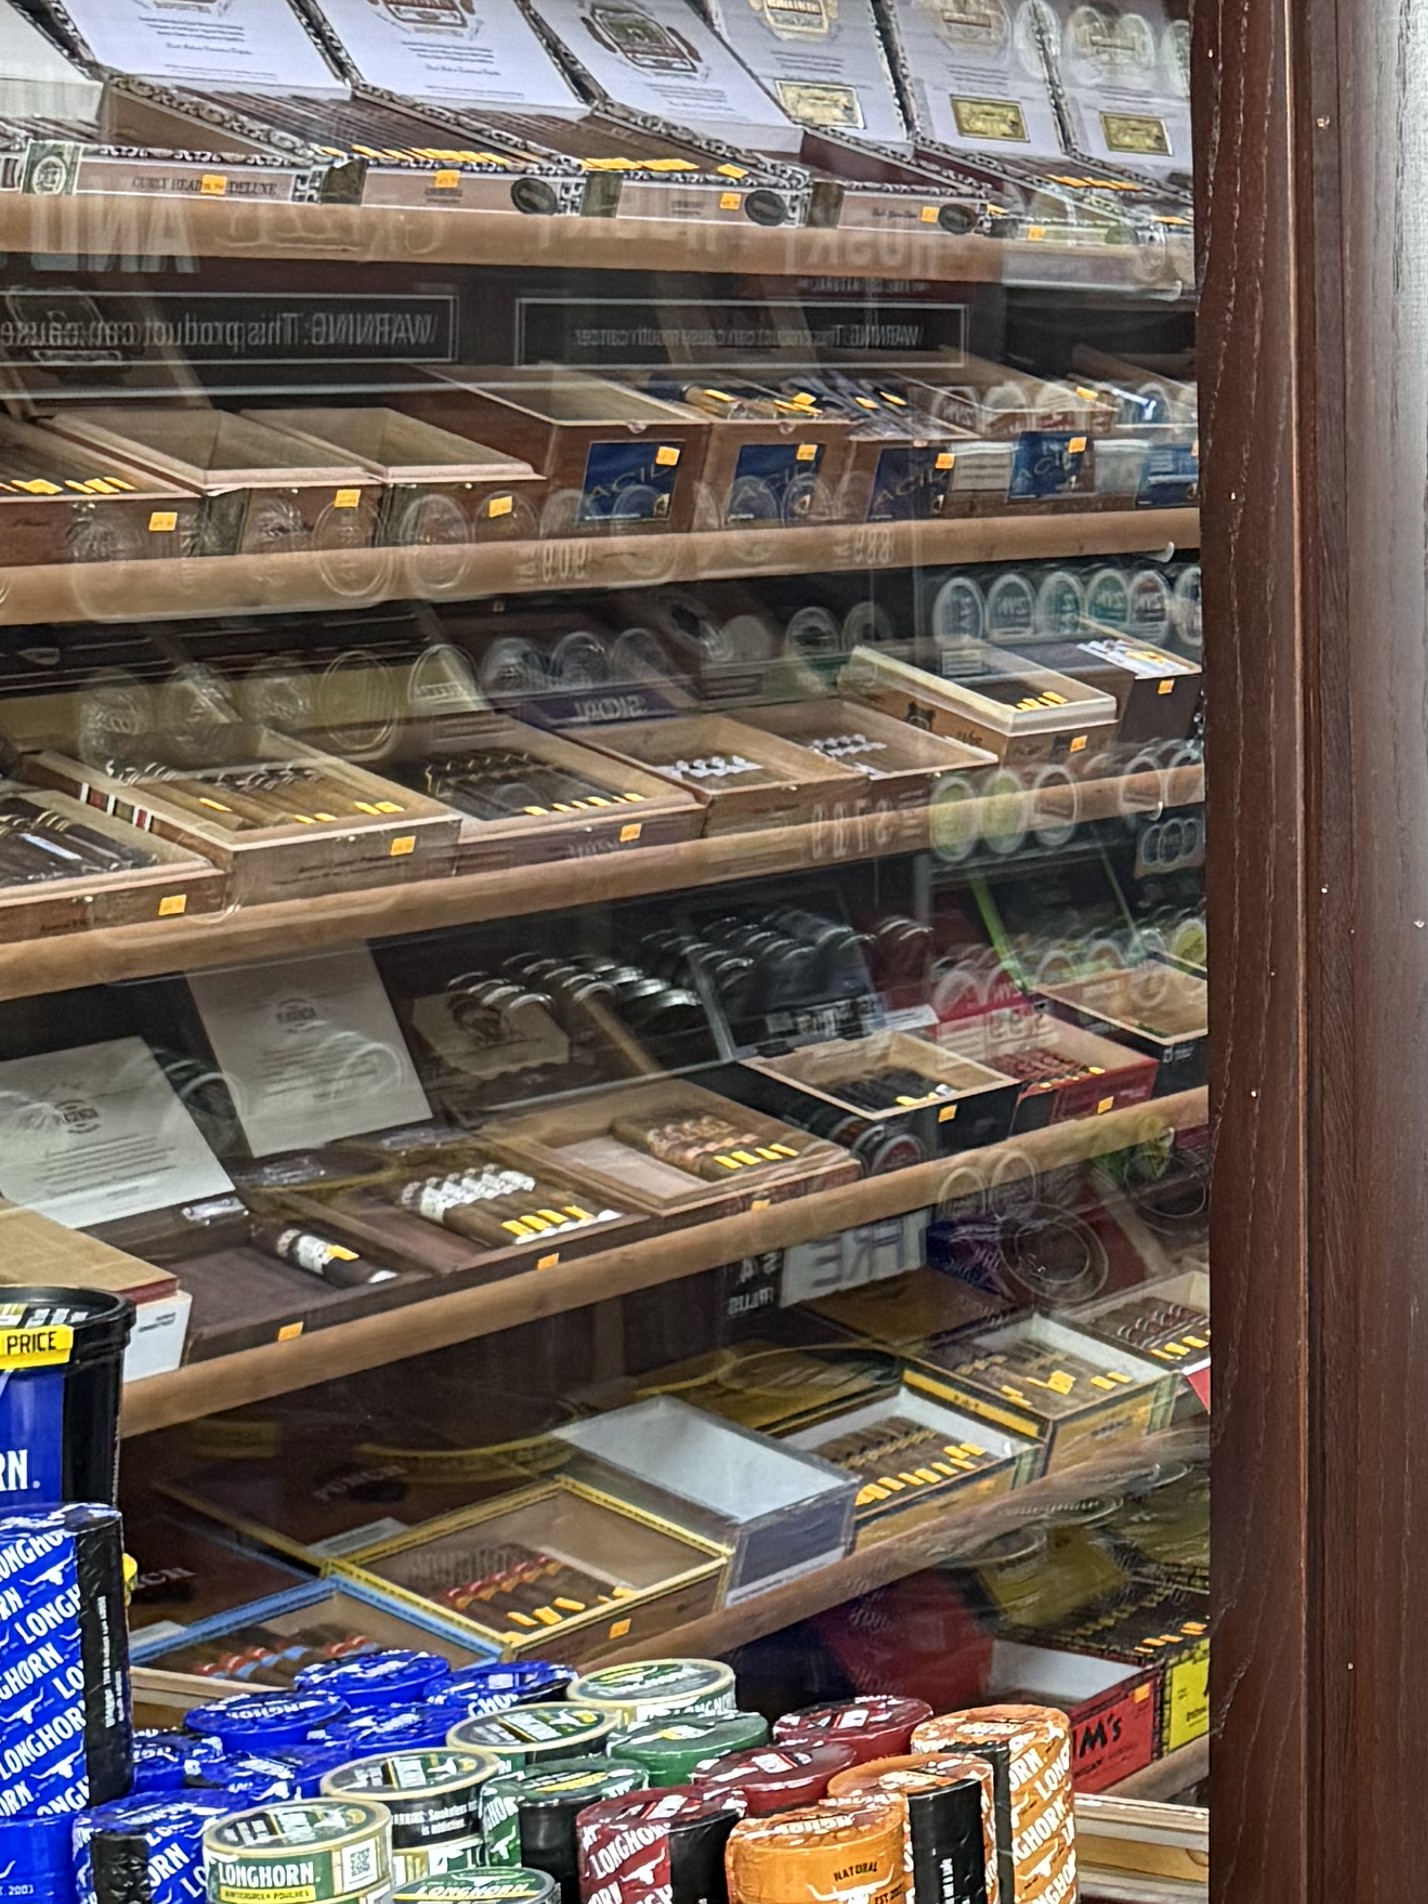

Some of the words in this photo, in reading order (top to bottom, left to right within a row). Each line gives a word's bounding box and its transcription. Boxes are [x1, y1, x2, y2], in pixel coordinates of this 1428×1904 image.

[229, 181, 277, 196] DELUXE
[6, 1330, 57, 1353] PRICE
[218, 1861, 314, 1888] LONGHORN
[833, 1861, 878, 1882] NATURAL
